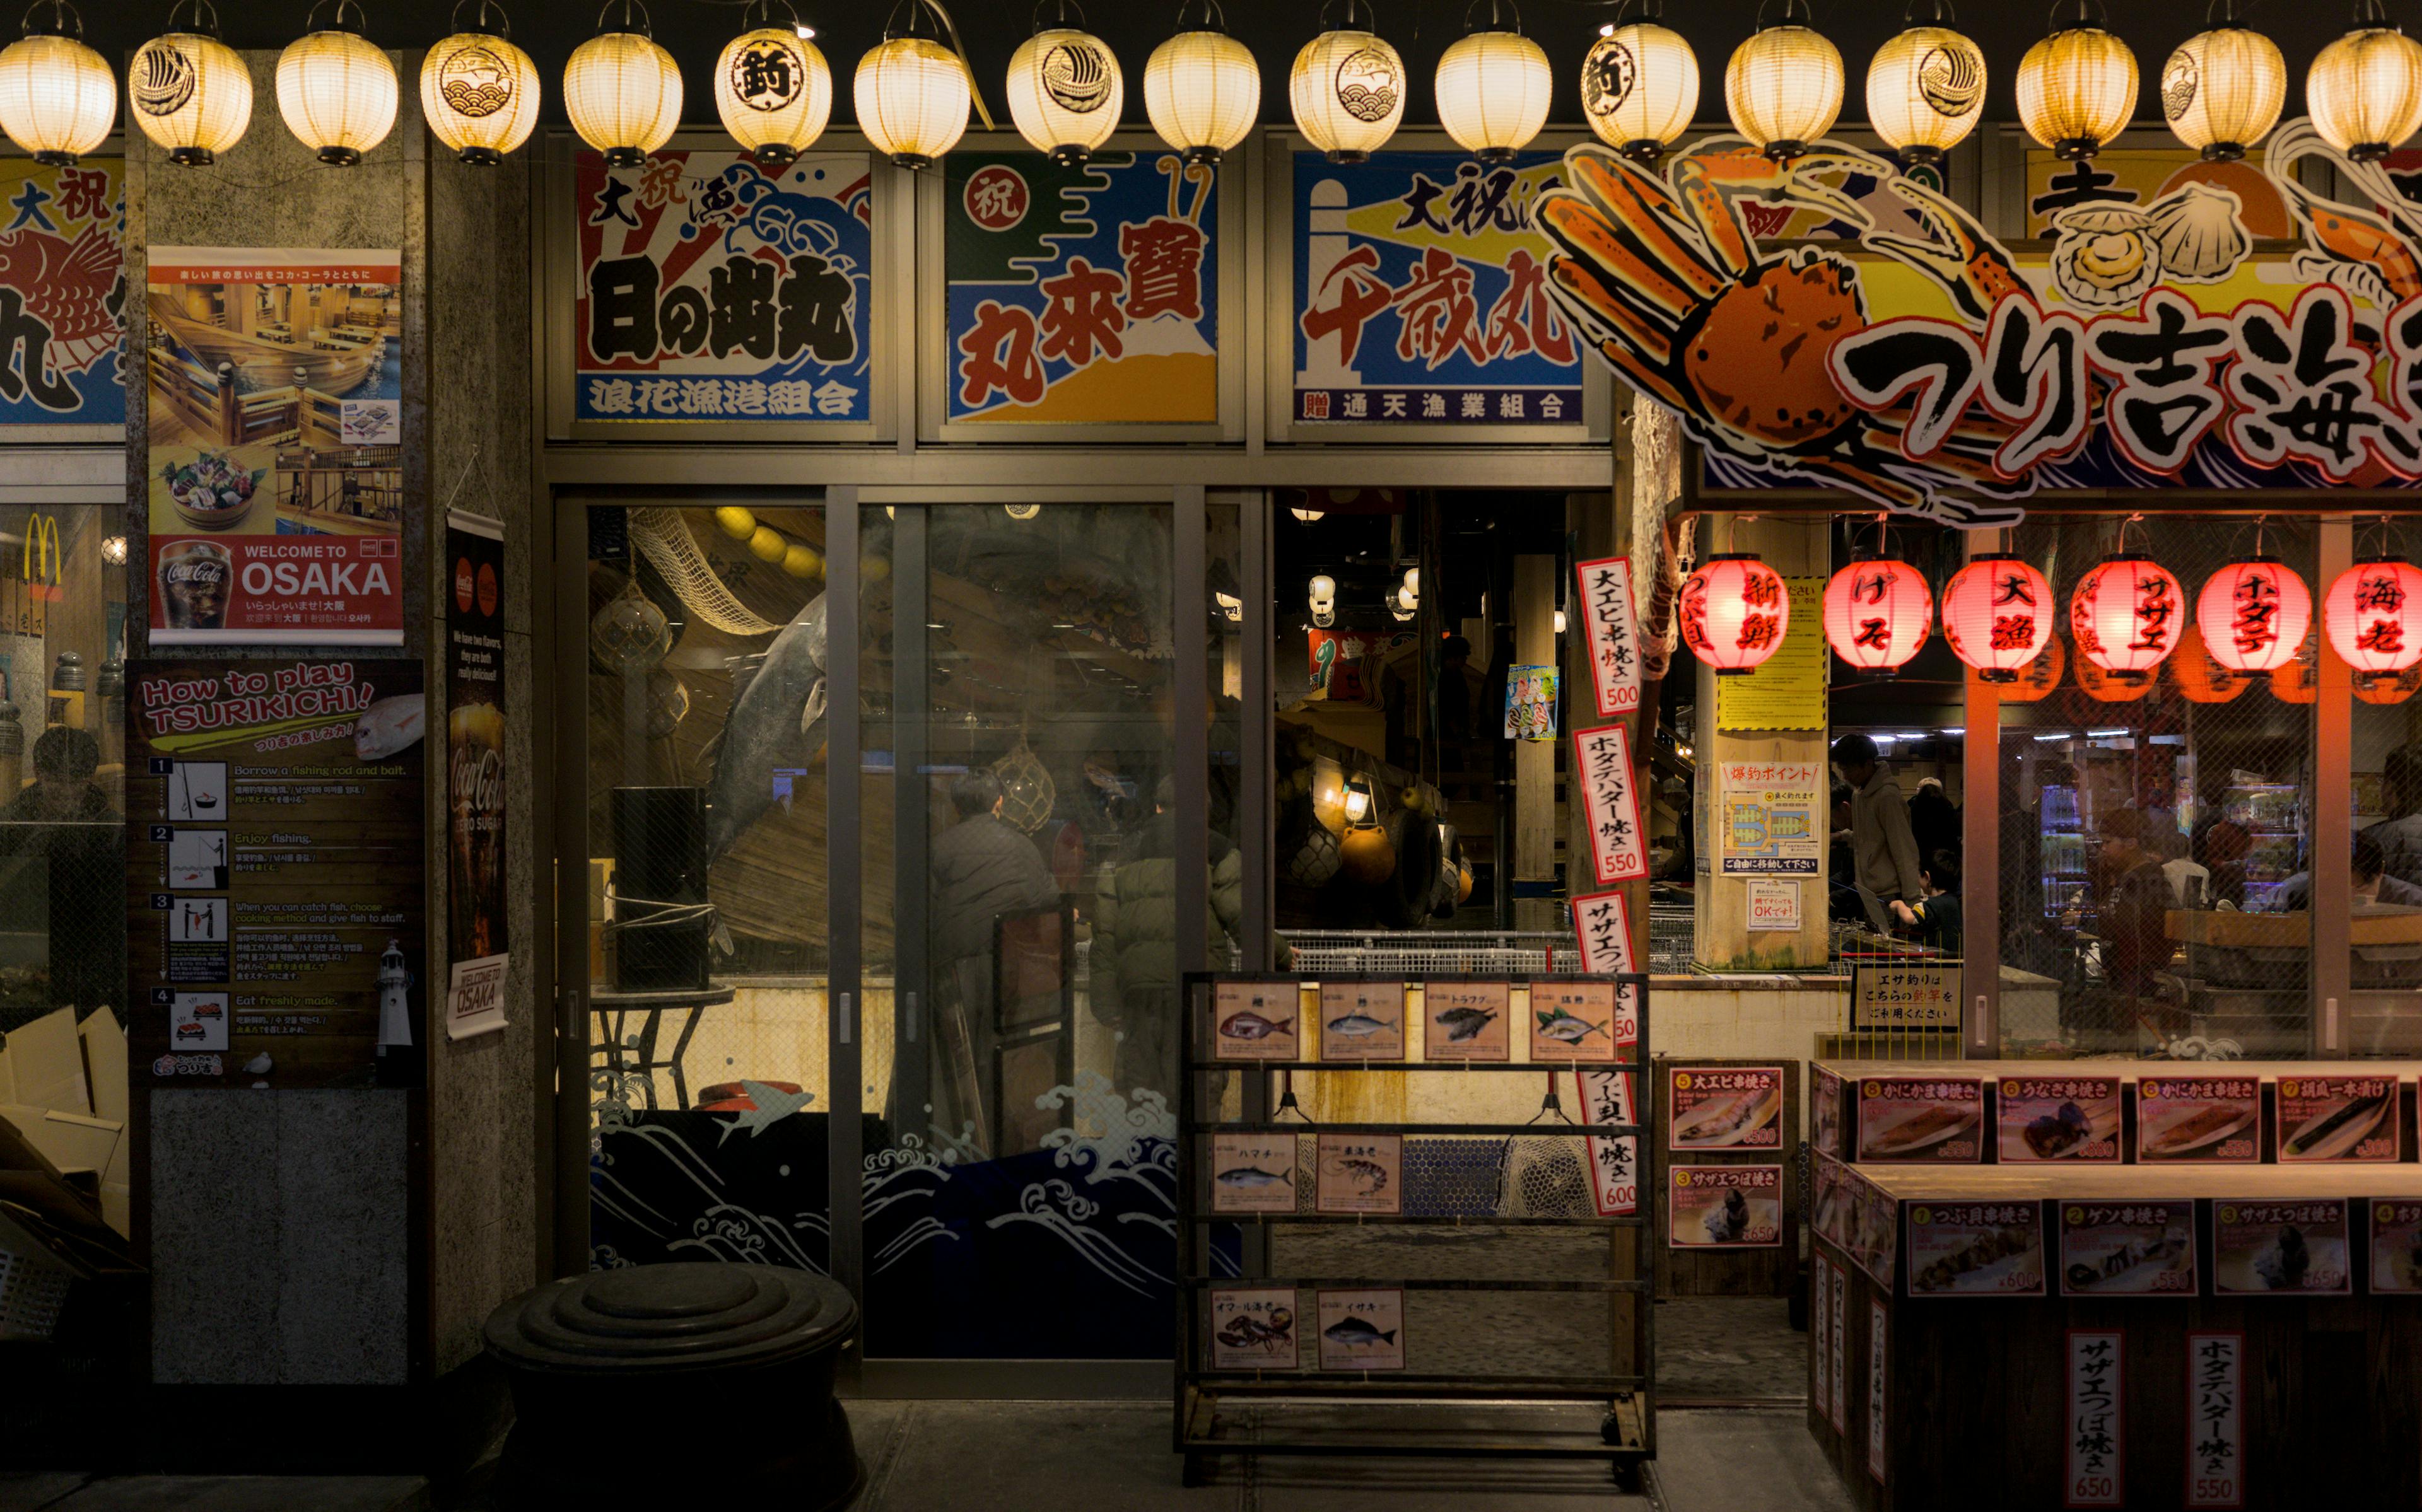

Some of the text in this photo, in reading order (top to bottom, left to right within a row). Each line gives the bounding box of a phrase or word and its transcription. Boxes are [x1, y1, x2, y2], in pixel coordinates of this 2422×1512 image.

[973, 177, 1019, 220] 祝
[590, 253, 856, 362] 日の出丸
[1839, 294, 2422, 471] つり吉海
[589, 379, 859, 416] 浪花漁港組合
[1343, 393, 1564, 418] 通天漁業組合
[245, 546, 347, 558] WELCOME TO
[167, 561, 221, 584] Coca-Cola
[242, 562, 392, 596] OSAKA
[311, 614, 371, 623] 환영합니다 오사카
[1736, 572, 1781, 651] 新鮮
[1991, 573, 2036, 651] 大漁
[2232, 574, 2279, 654] ホタテ
[2356, 576, 2406, 653] 海老
[1591, 569, 1634, 683] 大エビ串焼き
[462, 631, 473, 645] have
[143, 662, 354, 706] How to play
[1606, 685, 1639, 707] 500
[146, 682, 375, 734] TSURIKICHI!
[158, 759, 165, 772] 1
[234, 765, 407, 777] Borrow a fishing rod and bait.
[1730, 766, 1811, 781] 爆釣ポイント
[1587, 737, 1633, 851] ホタテバター焼き
[476, 817, 503, 831] SUGAR
[156, 828, 167, 839] 2
[234, 833, 312, 844] Enjoy fishing.
[1605, 853, 1637, 873] 550
[1725, 859, 1815, 869] ご自由に移動して下さい
[156, 896, 168, 908] 3
[235, 902, 260, 912] When
[262, 904, 280, 912] you
[300, 902, 327, 912] catch
[350, 902, 382, 912] choose
[235, 915, 271, 924] cooking
[273, 915, 307, 923] method
[309, 915, 327, 923] and
[329, 916, 348, 924] give
[349, 915, 366, 923] fish
[380, 914, 406, 923] staff.
[460, 968, 501, 987] WELCOME TO
[1879, 974, 1941, 986] エサ釣りは
[158, 990, 168, 1003] 4
[236, 996, 338, 1007] Eat freshly made.
[457, 983, 494, 1013] OSAKA
[1866, 989, 1953, 1003] こちらの釣竿を
[1869, 1008, 1947, 1019] ご利用ください
[1616, 1018, 1635, 1038] 50
[1693, 1074, 1771, 1090] 大エビ串焼き
[2023, 1082, 2109, 1098] うなぎ串焼き
[2162, 1081, 2254, 1098] かにかま串焼き
[1883, 1083, 1977, 1100] かにかま串焼き
[1239, 1149, 1272, 1159] ハマチ
[1692, 1171, 1776, 1187] サザエつぼ焼き
[1606, 1186, 1636, 1205] 600
[1934, 1206, 2032, 1225] つぶ貝串焼き
[2240, 1206, 2339, 1223] サザエつぼ焼き
[1347, 1302, 1376, 1312] イサキ
[2076, 1340, 2114, 1474] サザエつぼ焼き
[2196, 1341, 2234, 1475] ホタテバター焼き
[2076, 1477, 2112, 1497] 650
[2196, 1479, 2233, 1498] 550
